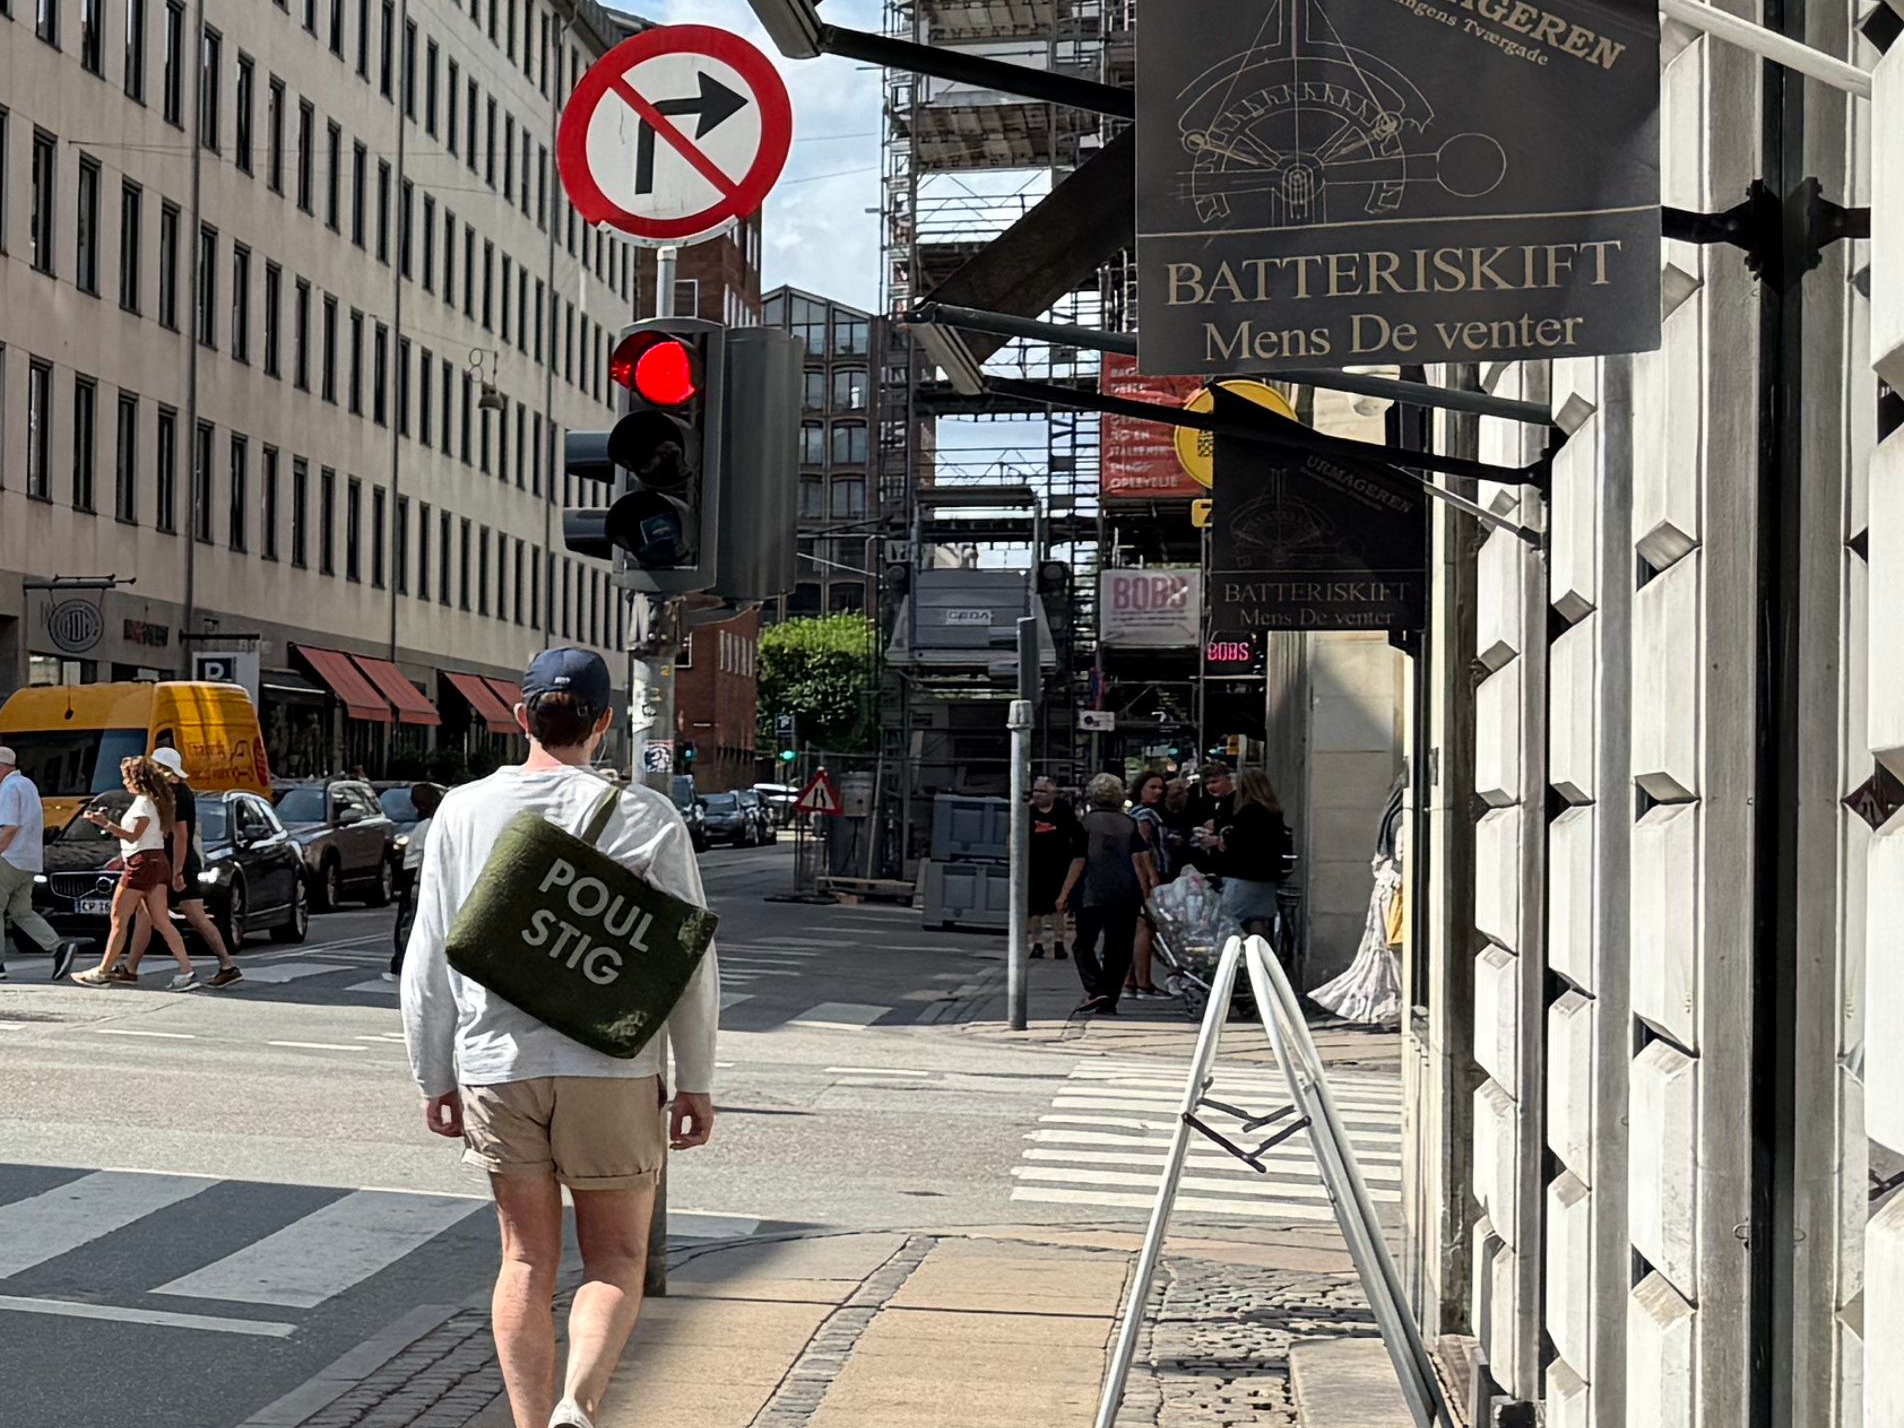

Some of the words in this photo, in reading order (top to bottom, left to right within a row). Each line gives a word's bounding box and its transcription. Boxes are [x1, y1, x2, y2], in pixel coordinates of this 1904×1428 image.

[1463, 17, 1548, 67] Tværgade
[1165, 239, 1622, 306] BATTERISKIFT
[1202, 316, 1331, 362] Mens
[1349, 313, 1418, 354] De
[1433, 315, 1583, 349] venter
[1306, 454, 1413, 513] URMAGEREN
[1225, 582, 1411, 603] BATTERISKIFT
[1240, 608, 1291, 626] Mens
[1300, 608, 1322, 625] De
[1335, 612, 1395, 626] venter
[1207, 641, 1250, 662] BOBS
[538, 858, 655, 954] POUL
[521, 909, 624, 985] STIG
